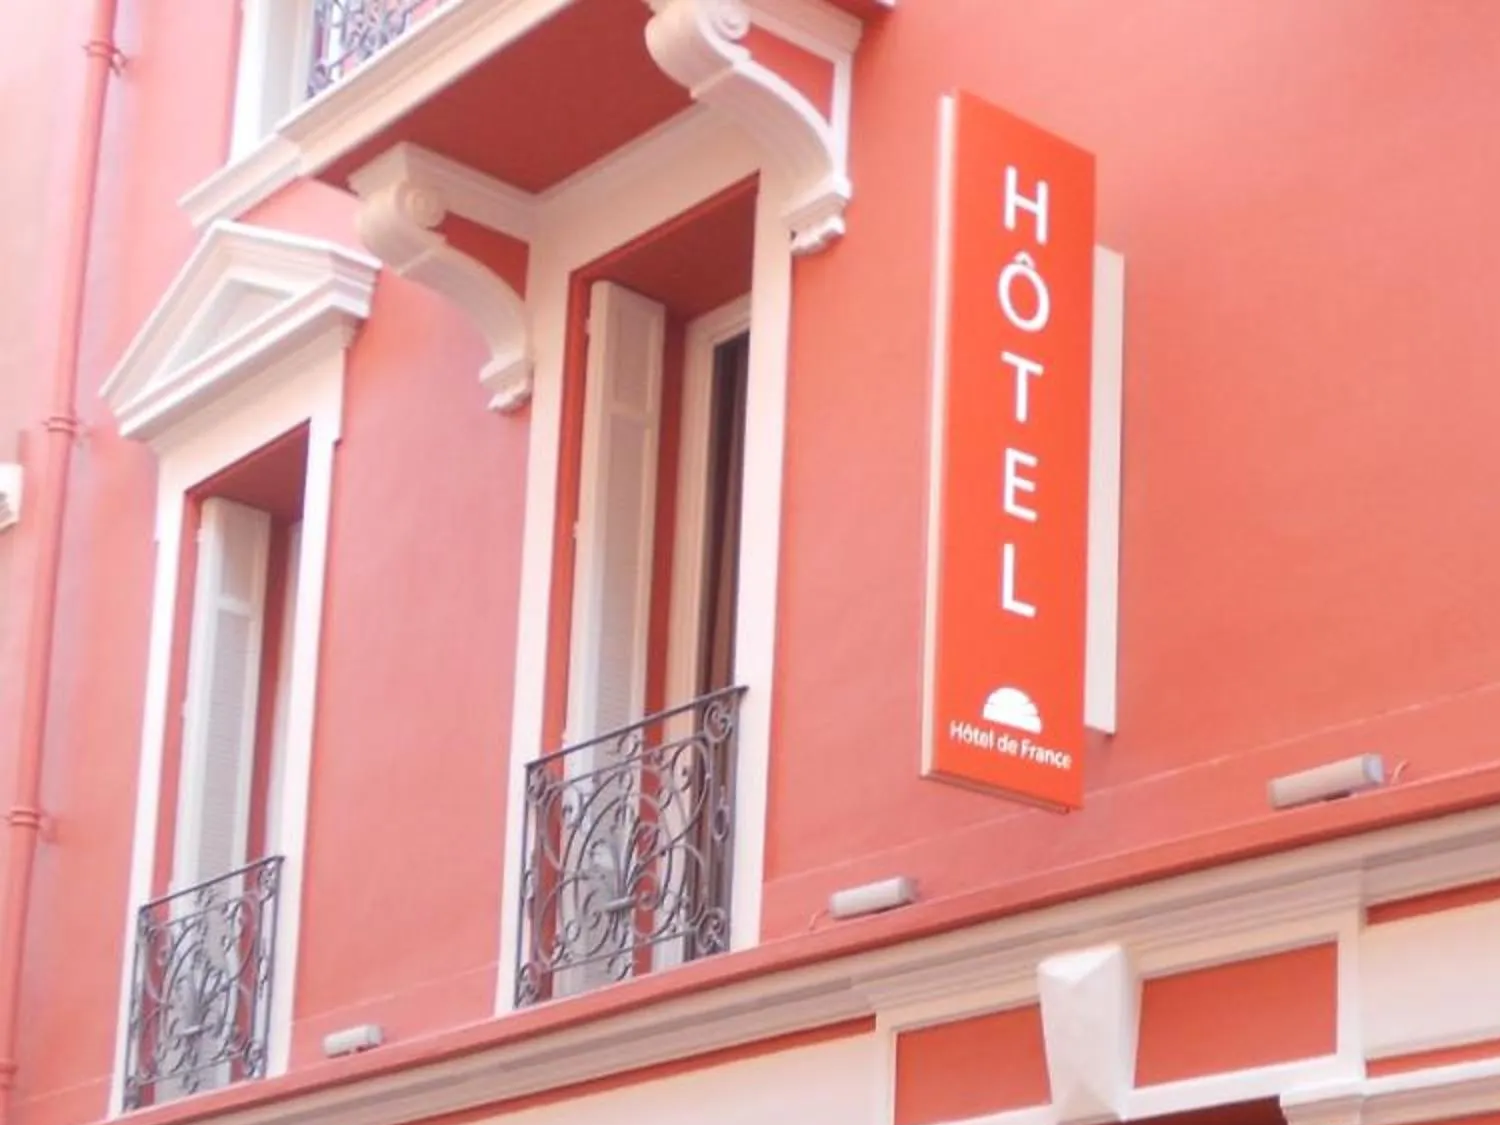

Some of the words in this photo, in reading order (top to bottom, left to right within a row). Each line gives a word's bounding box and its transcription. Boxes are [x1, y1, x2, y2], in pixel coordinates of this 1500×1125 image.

[998, 165, 1050, 618] HÔTEL
[949, 719, 994, 751] Hôtel
[997, 733, 1019, 757] de
[1020, 738, 1073, 770] France
